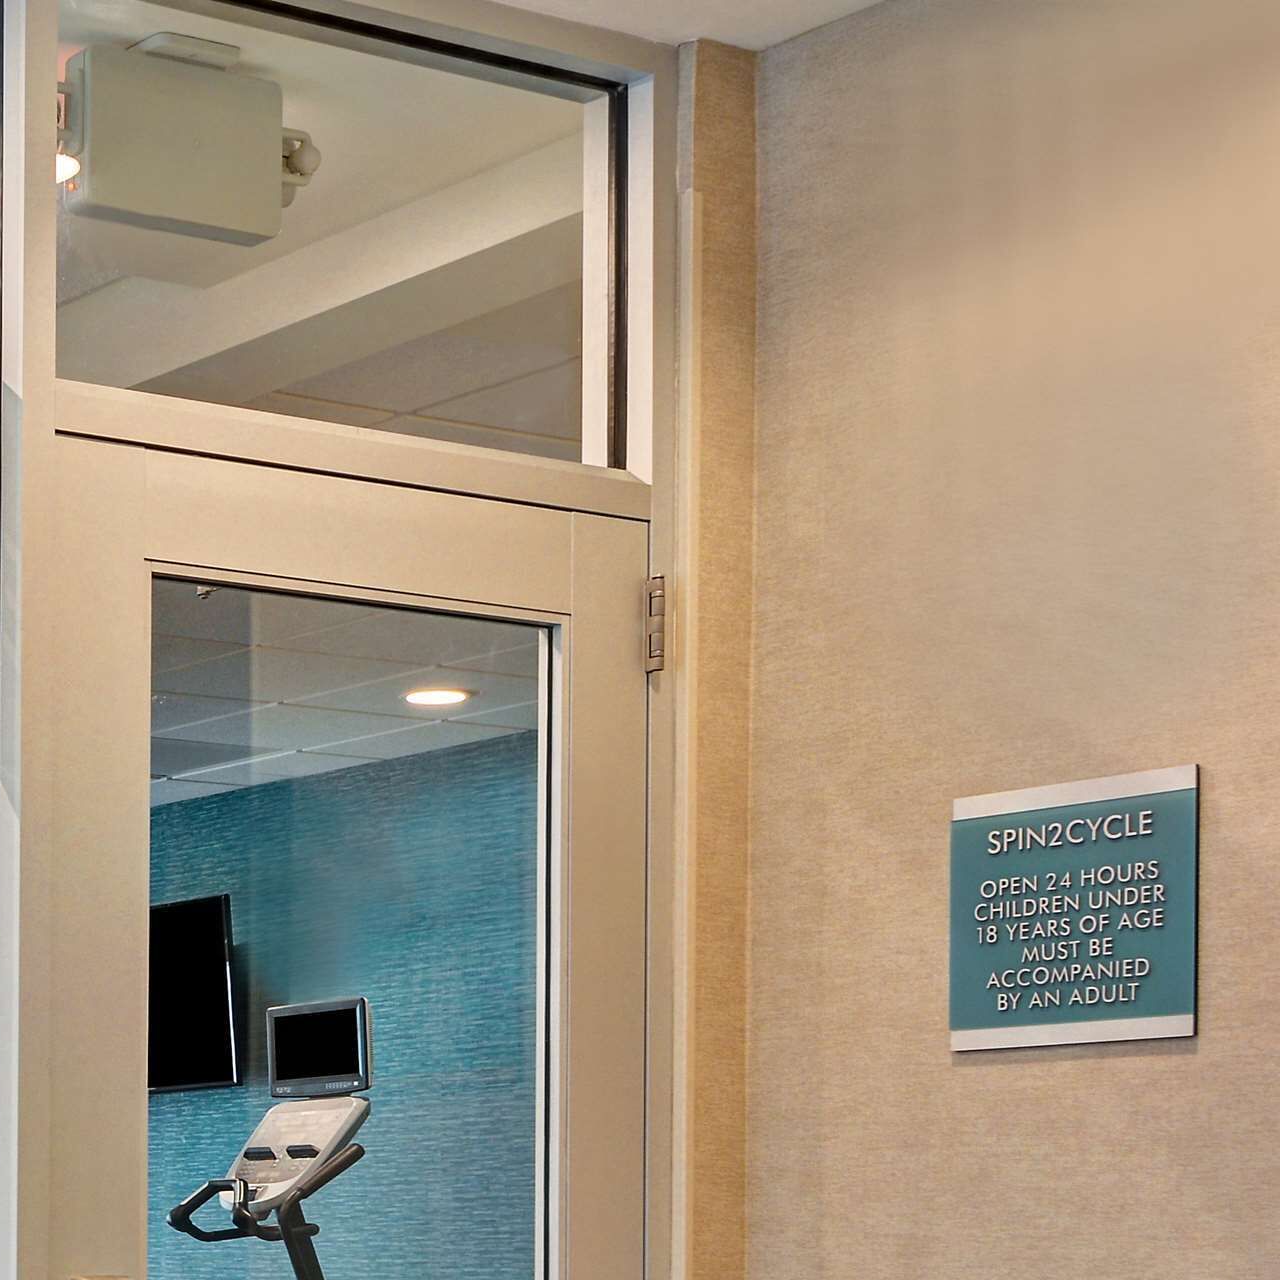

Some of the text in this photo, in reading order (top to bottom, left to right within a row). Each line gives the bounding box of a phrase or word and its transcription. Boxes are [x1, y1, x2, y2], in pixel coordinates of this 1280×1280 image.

[987, 811, 1153, 854] SPIN2CYCLE
[980, 860, 1159, 899] OPEN 24 HOURS
[974, 884, 1166, 922] CHILDREN UNDER
[976, 908, 1164, 945] 18 YEARS OF AGE
[1021, 937, 1114, 963] MUST BE
[986, 958, 1150, 989] ACCOMPANIED
[997, 983, 1141, 1012] BY AN ADULT
